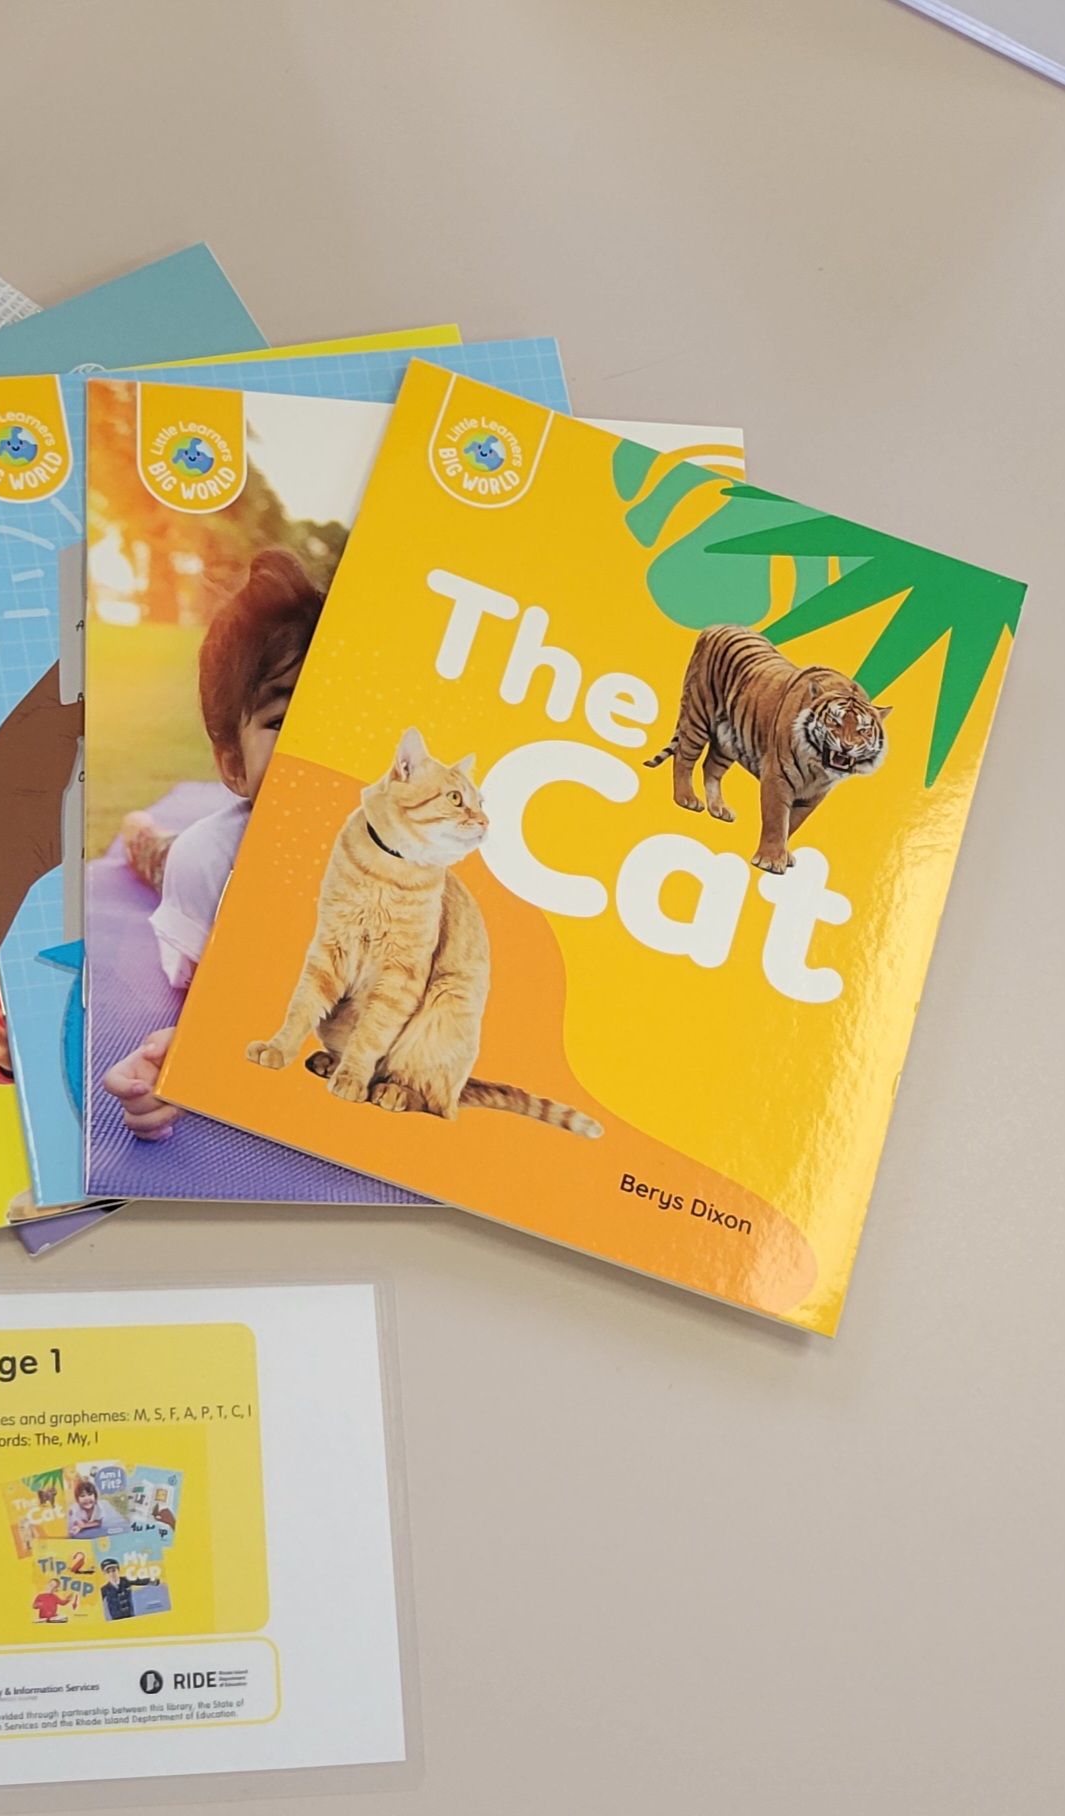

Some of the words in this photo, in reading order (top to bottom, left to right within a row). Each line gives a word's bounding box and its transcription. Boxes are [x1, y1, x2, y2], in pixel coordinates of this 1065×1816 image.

[150, 422, 178, 456] Little
[178, 420, 232, 463] Learners
[446, 418, 478, 442] Little
[481, 416, 522, 467] Learners
[8, 451, 63, 491] WORLD
[147, 461, 178, 492] BIG
[181, 466, 237, 500] WORLD
[438, 447, 463, 477] BIG
[462, 469, 520, 495] WORLD
[426, 568, 659, 748] The
[478, 739, 852, 1004] Cat
[620, 1173, 684, 1210] Berys
[690, 1198, 752, 1235] Dixon
[50, 1348, 61, 1373] 1
[20, 1412, 46, 1426] and
[50, 1409, 130, 1428] graphemes:
[134, 1408, 151, 1422] M,
[154, 1408, 166, 1422] S,
[170, 1407, 180, 1421] F,
[184, 1406, 197, 1420] A,
[201, 1406, 213, 1420] P,
[216, 1405, 228, 1419] T,
[231, 1405, 244, 1419] C,
[34, 1432, 63, 1447] The,
[67, 1431, 91, 1447] My,
[99, 1471, 116, 1480] Am
[101, 1479, 122, 1490] Fit?
[27, 1504, 65, 1525] Cat
[37, 1557, 66, 1575] Tip
[123, 1551, 149, 1566] My
[126, 1565, 161, 1582] Cap
[60, 1576, 94, 1597] Tap
[5, 1687, 11, 1696] &
[14, 1684, 63, 1695] Information
[65, 1683, 99, 1693] Services
[173, 1671, 217, 1690] RIDE
[26, 1710, 59, 1721] through
[61, 1706, 109, 1719] partnership
[112, 1705, 147, 1715] between
[149, 1703, 164, 1712] this
[197, 1701, 211, 1710] the
[213, 1699, 234, 1709] State
[236, 1698, 245, 1708] of
[4, 1720, 39, 1731] Services
[41, 1719, 58, 1728] and
[60, 1718, 74, 1727] the
[75, 1717, 102, 1727] Rhode
[104, 1715, 130, 1725] Island
[185, 1711, 194, 1721] of
